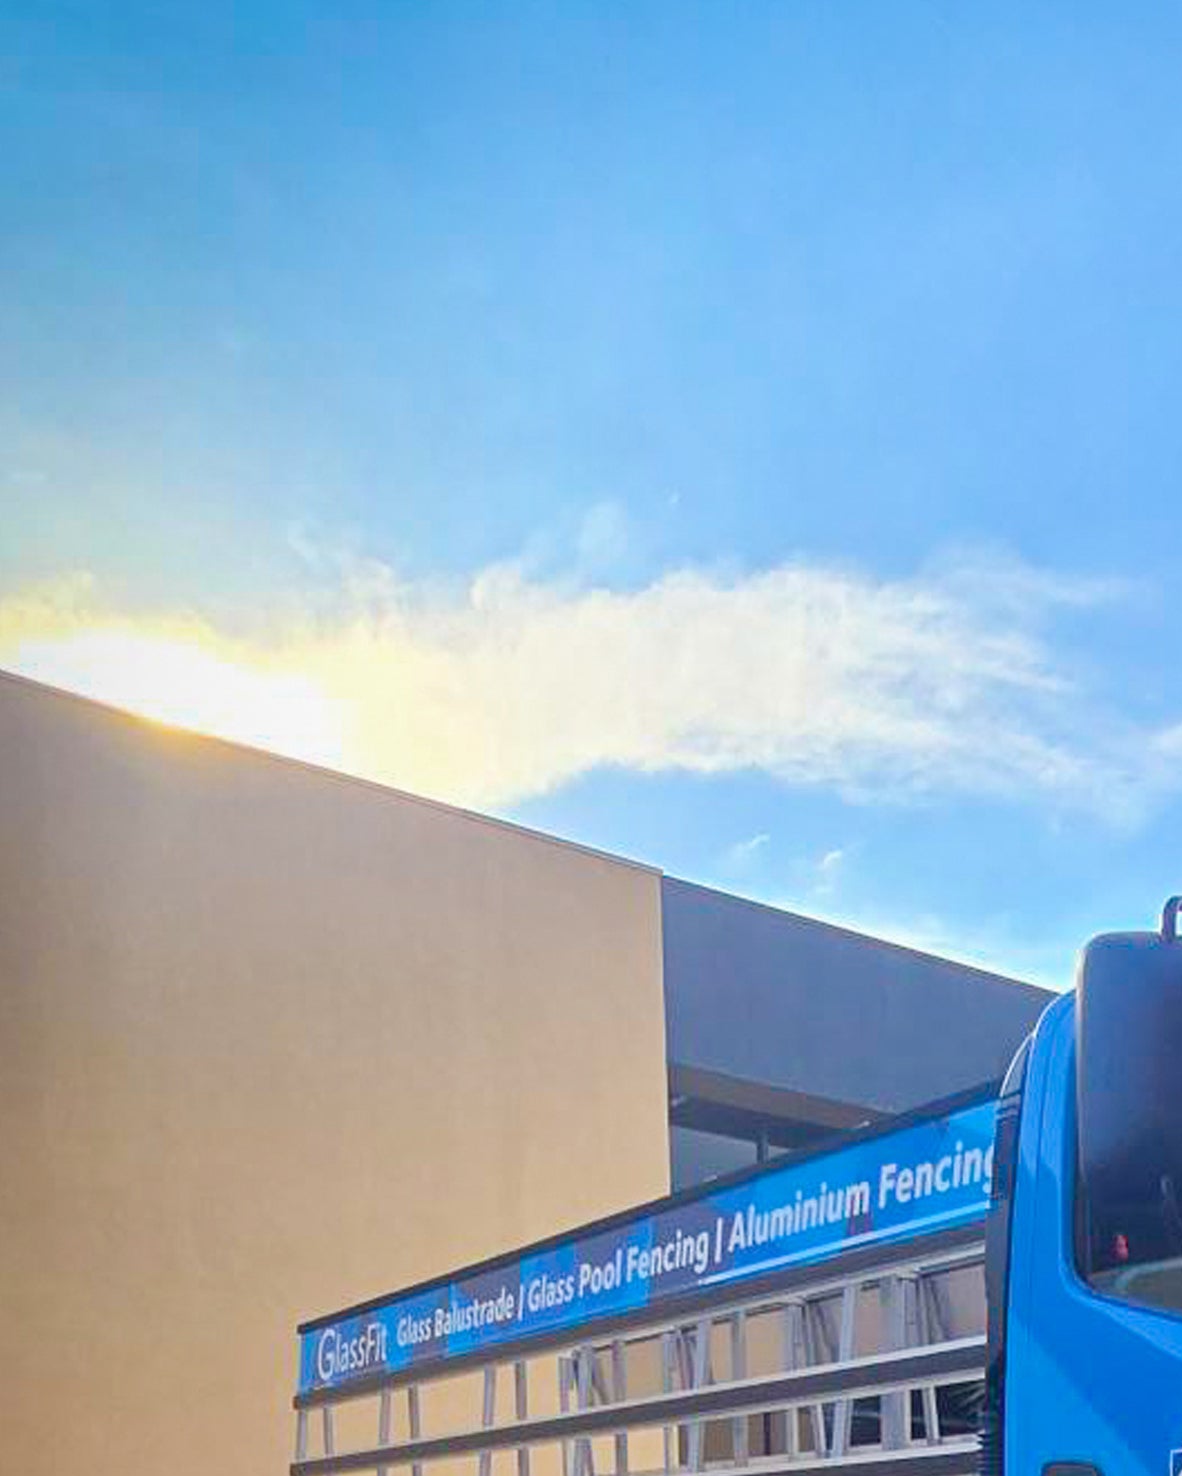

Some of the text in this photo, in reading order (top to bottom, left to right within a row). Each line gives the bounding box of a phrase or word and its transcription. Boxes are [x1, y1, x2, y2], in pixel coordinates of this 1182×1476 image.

[396, 1314, 432, 1347] Glass
[434, 1286, 514, 1336] Balustrade
[528, 1272, 575, 1311] Glass
[579, 1249, 622, 1298] Pool
[626, 1228, 709, 1282] Fencing
[728, 1181, 871, 1253] Aluminium
[317, 1322, 387, 1381] GlassFit
